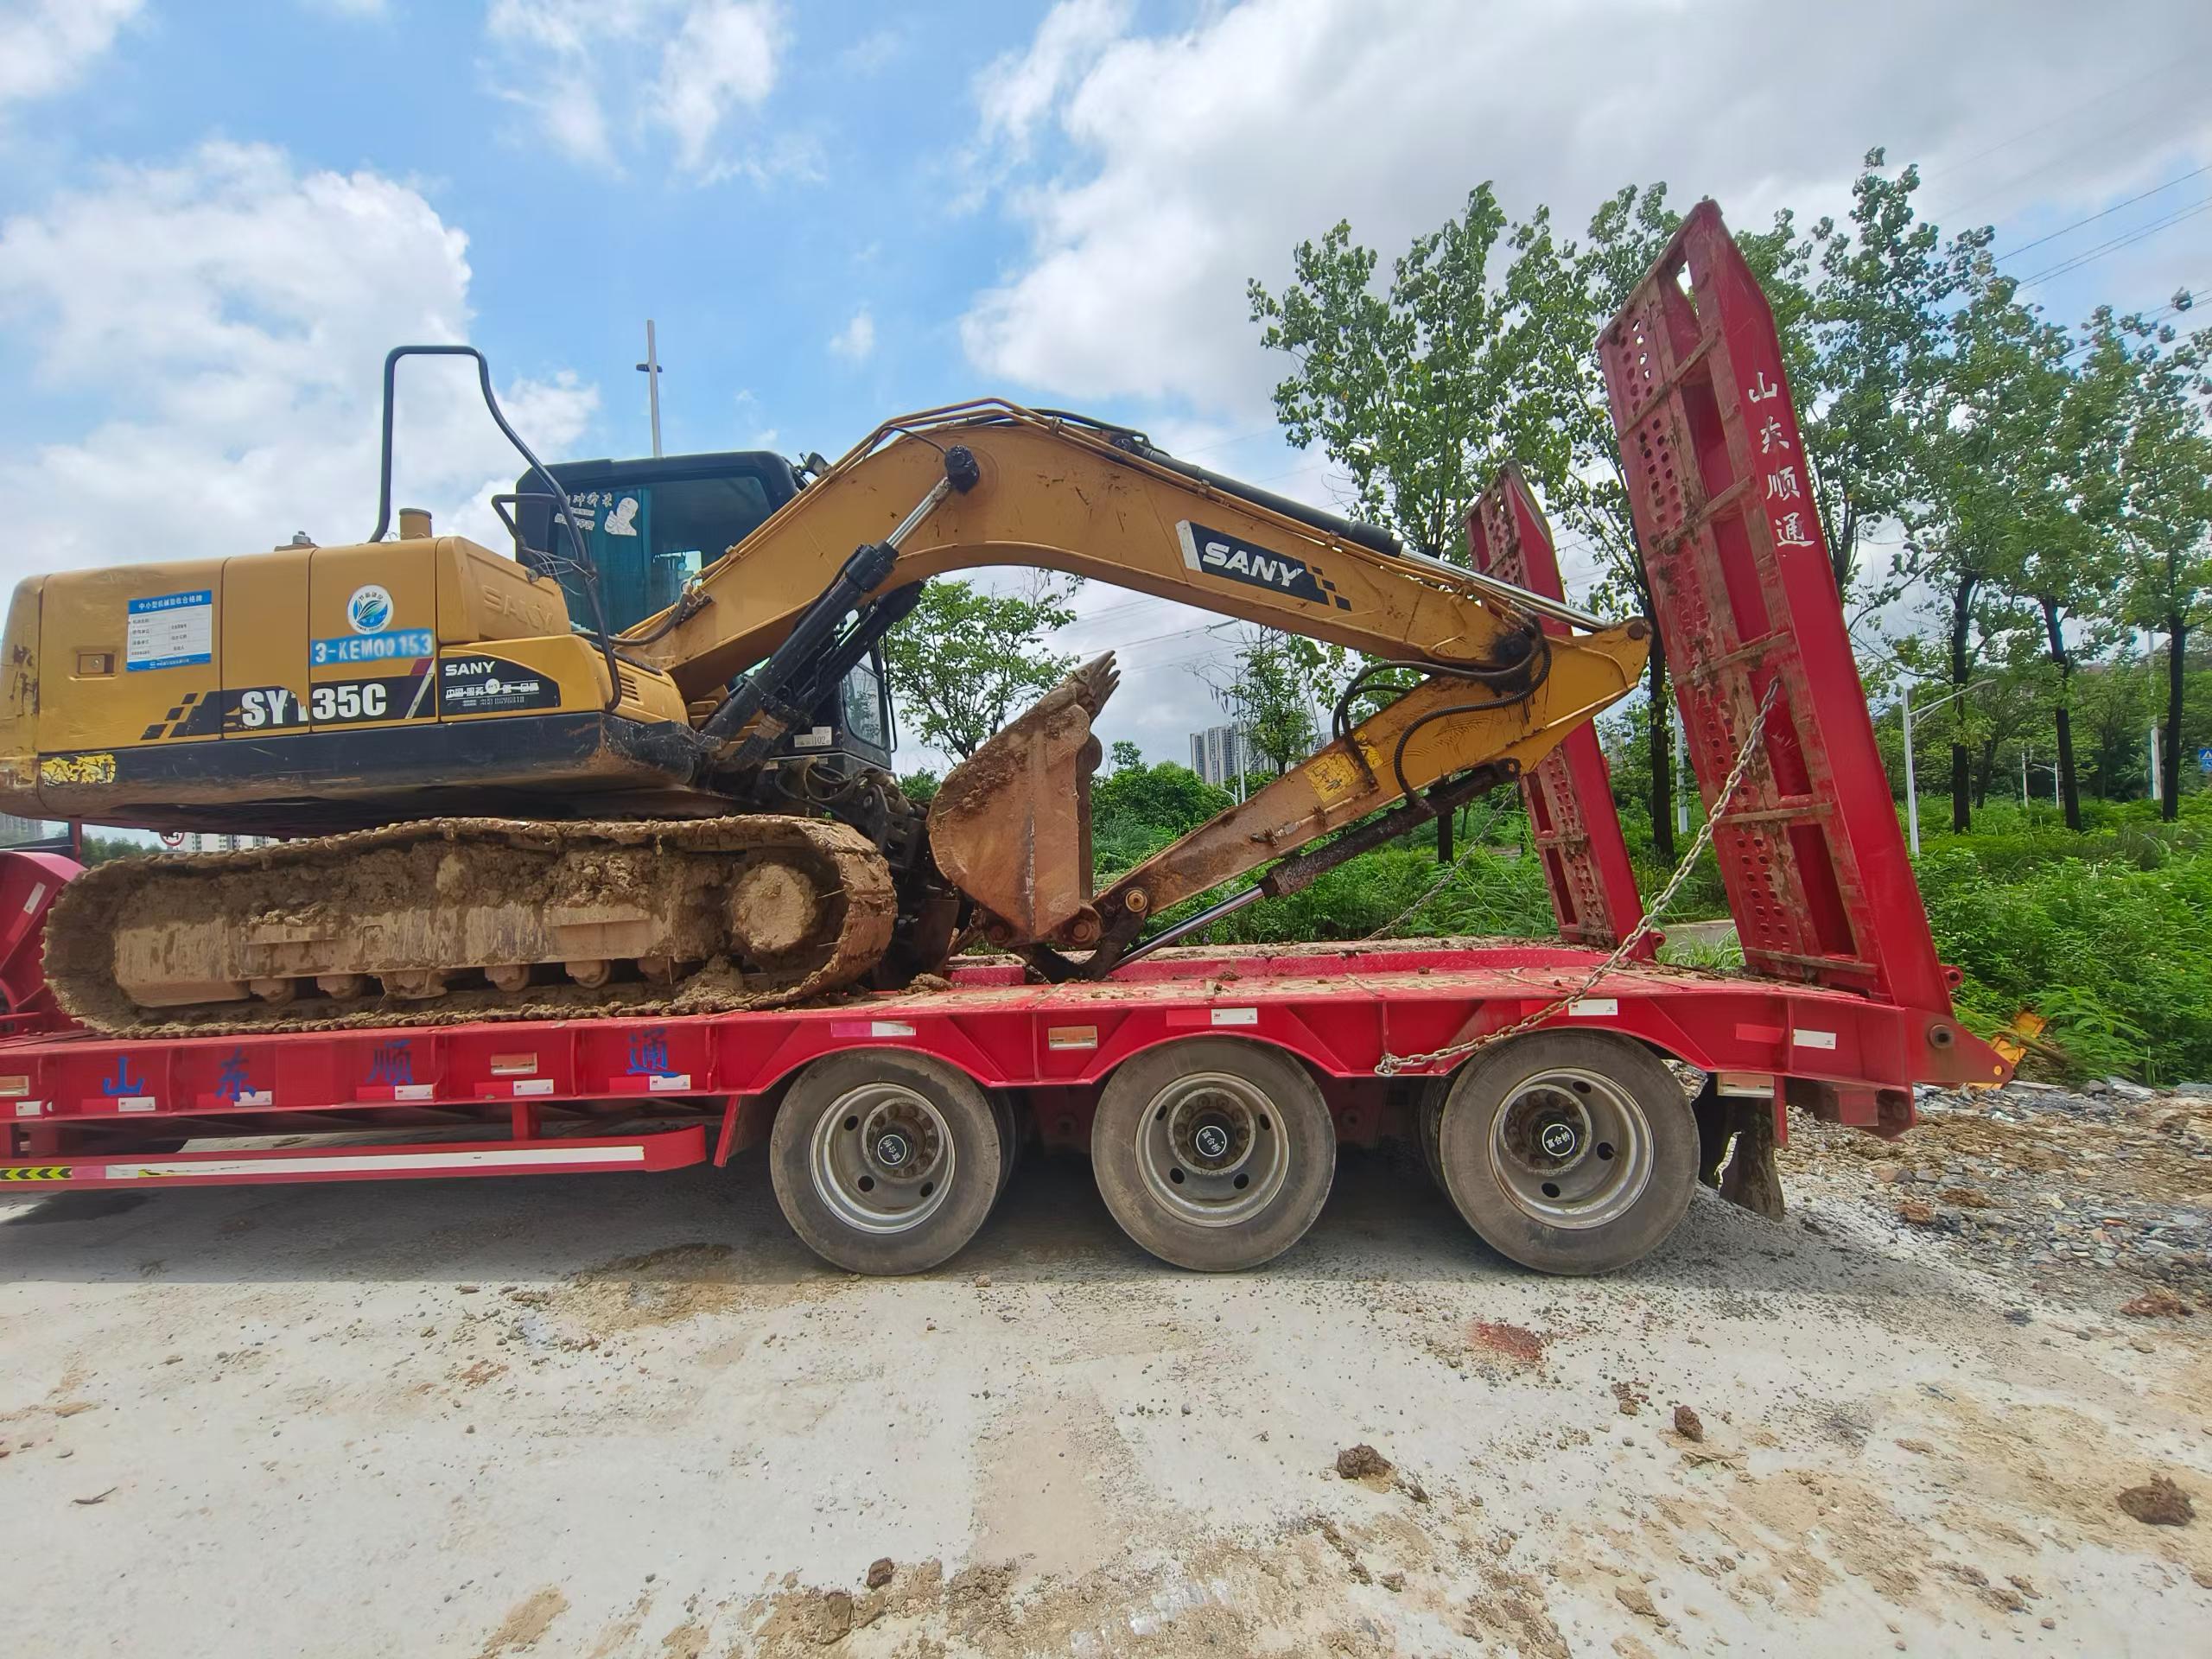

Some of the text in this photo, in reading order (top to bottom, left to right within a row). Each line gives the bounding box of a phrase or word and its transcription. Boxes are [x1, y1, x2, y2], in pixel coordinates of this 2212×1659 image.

[1748, 372, 1815, 547] 山东顺通
[1202, 541, 1306, 588] SANY
[445, 661, 496, 677] SANY
